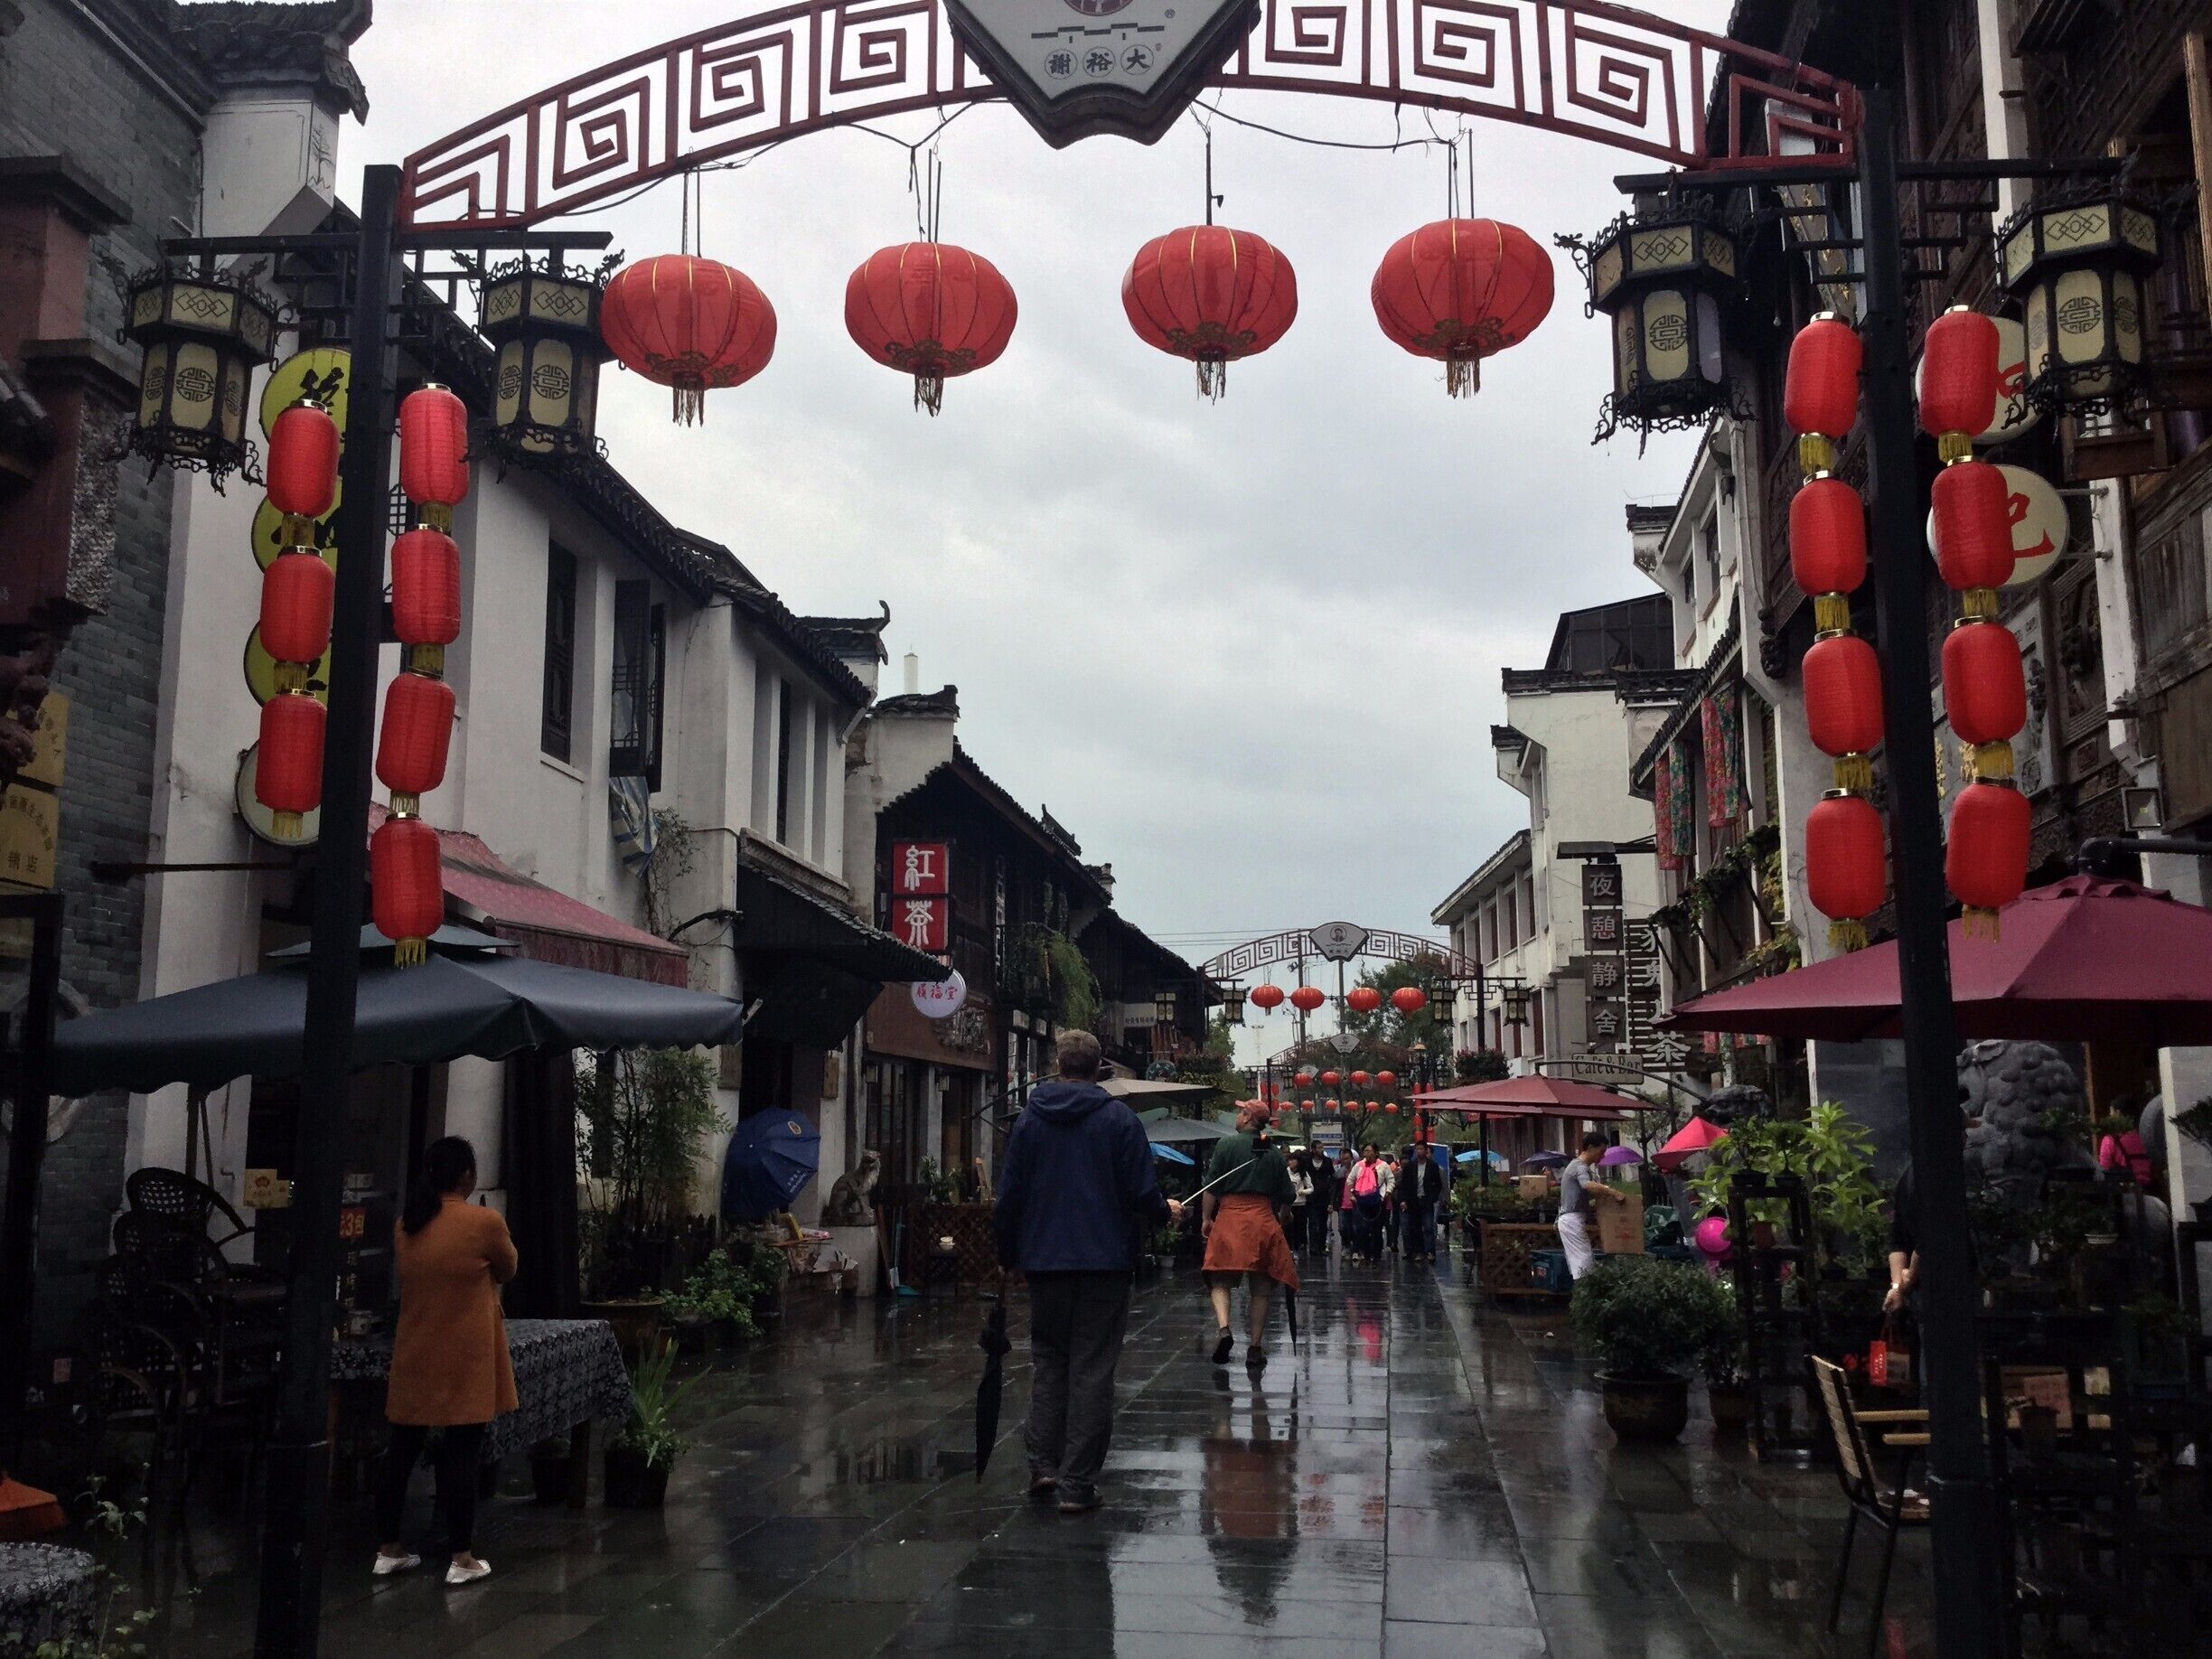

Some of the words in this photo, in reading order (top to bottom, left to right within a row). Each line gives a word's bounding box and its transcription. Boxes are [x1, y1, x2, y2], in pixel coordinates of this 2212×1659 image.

[1048, 48, 1150, 75] 謝裕大
[1589, 873, 1619, 1036] 夜憩静舍
